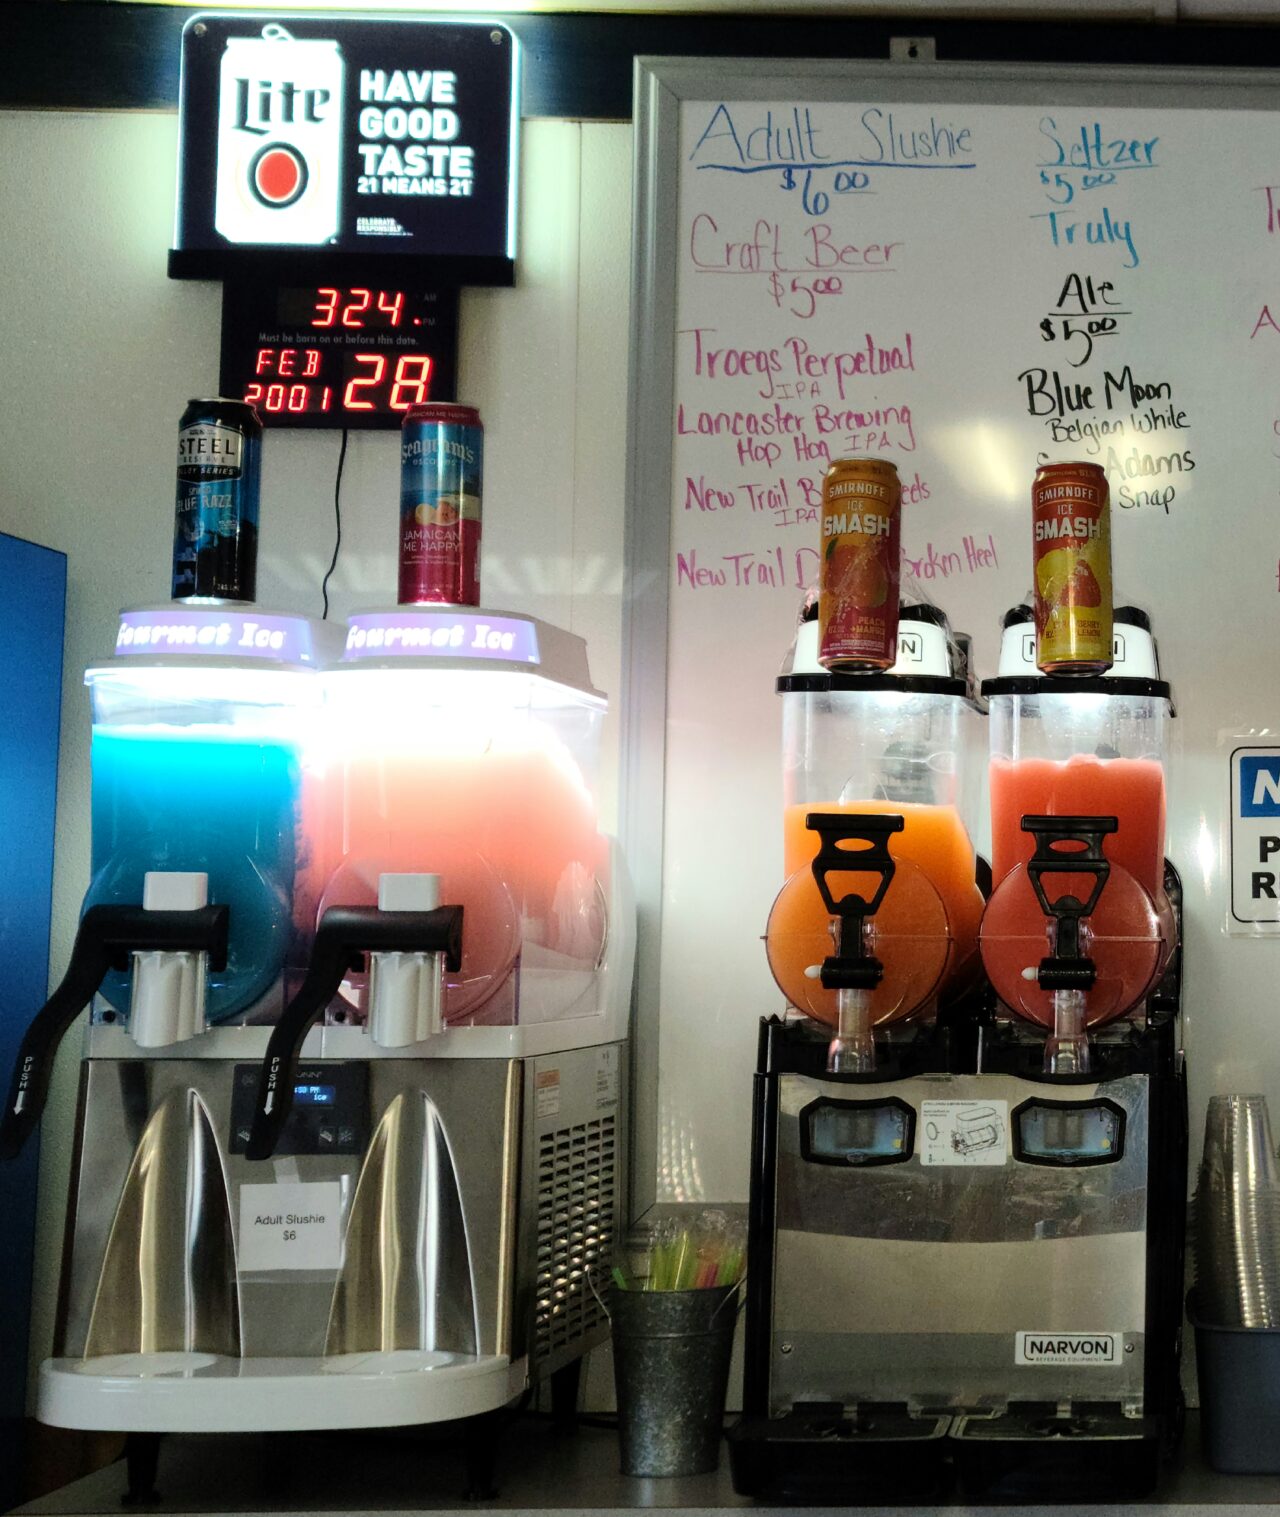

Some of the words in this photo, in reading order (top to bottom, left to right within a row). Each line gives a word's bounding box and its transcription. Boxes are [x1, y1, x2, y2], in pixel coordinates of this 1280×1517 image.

[360, 69, 456, 103] HAVE
[231, 77, 331, 136] Lite
[358, 107, 458, 140] GOOD
[689, 104, 831, 163] Adult
[859, 107, 973, 163] Slushie
[1037, 116, 1160, 170] Seltzer
[357, 145, 474, 177] TASTE
[357, 178, 379, 195] 21
[382, 178, 446, 195] MEANS
[448, 179, 472, 196] 21
[690, 213, 788, 272] Craft
[804, 223, 904, 269] Beer
[1029, 207, 1140, 268] Truly
[1056, 273, 1122, 313] Ale
[259, 333, 279, 342] Must
[282, 333, 293, 343] be
[296, 333, 316, 344] born
[320, 335, 331, 344] on
[333, 336, 343, 344] or
[345, 334, 375, 345] before
[377, 336, 394, 345] this
[396, 336, 419, 346] date.
[255, 349, 321, 376] FEB
[343, 354, 434, 411] 28
[676, 329, 782, 399] Troegs
[784, 333, 916, 400] Perpetual
[244, 384, 332, 411] 2001
[776, 381, 821, 400] IPA
[1018, 368, 1095, 417] Blue
[1104, 365, 1172, 410] Moon
[677, 403, 805, 436] Lancaster
[813, 404, 917, 451] Brewing
[1045, 417, 1125, 455] Belgian
[179, 438, 235, 455] STEEL
[737, 437, 781, 469] Hop
[793, 432, 831, 477] Hog
[843, 431, 892, 452] IPA
[1105, 446, 1196, 481] Adams
[685, 476, 735, 511] New
[738, 479, 789, 513] Trail
[829, 481, 886, 499] SMIRNOFF
[848, 500, 864, 511] ICE
[1039, 485, 1094, 503] SMIRNOFF
[1118, 485, 1176, 515] Snap
[774, 508, 819, 527] IPA
[823, 513, 890, 537] SMASH
[1057, 504, 1074, 515] ICE
[404, 530, 461, 541] JAMAICAN
[1035, 517, 1101, 542] SMASH
[404, 542, 417, 552] ME
[420, 541, 460, 552] HAPPY
[962, 534, 1000, 569] Heel
[677, 550, 727, 589] New
[722, 547, 786, 587] Trail
[238, 622, 287, 649] Ice
[471, 624, 515, 651] Ice
[18, 1056, 33, 1089] PUSH
[267, 1056, 280, 1089] PUSH
[254, 1213, 283, 1225] Adult
[285, 1213, 325, 1225] Slushie
[283, 1230, 297, 1242] $6
[1030, 1340, 1108, 1355] NARVON
